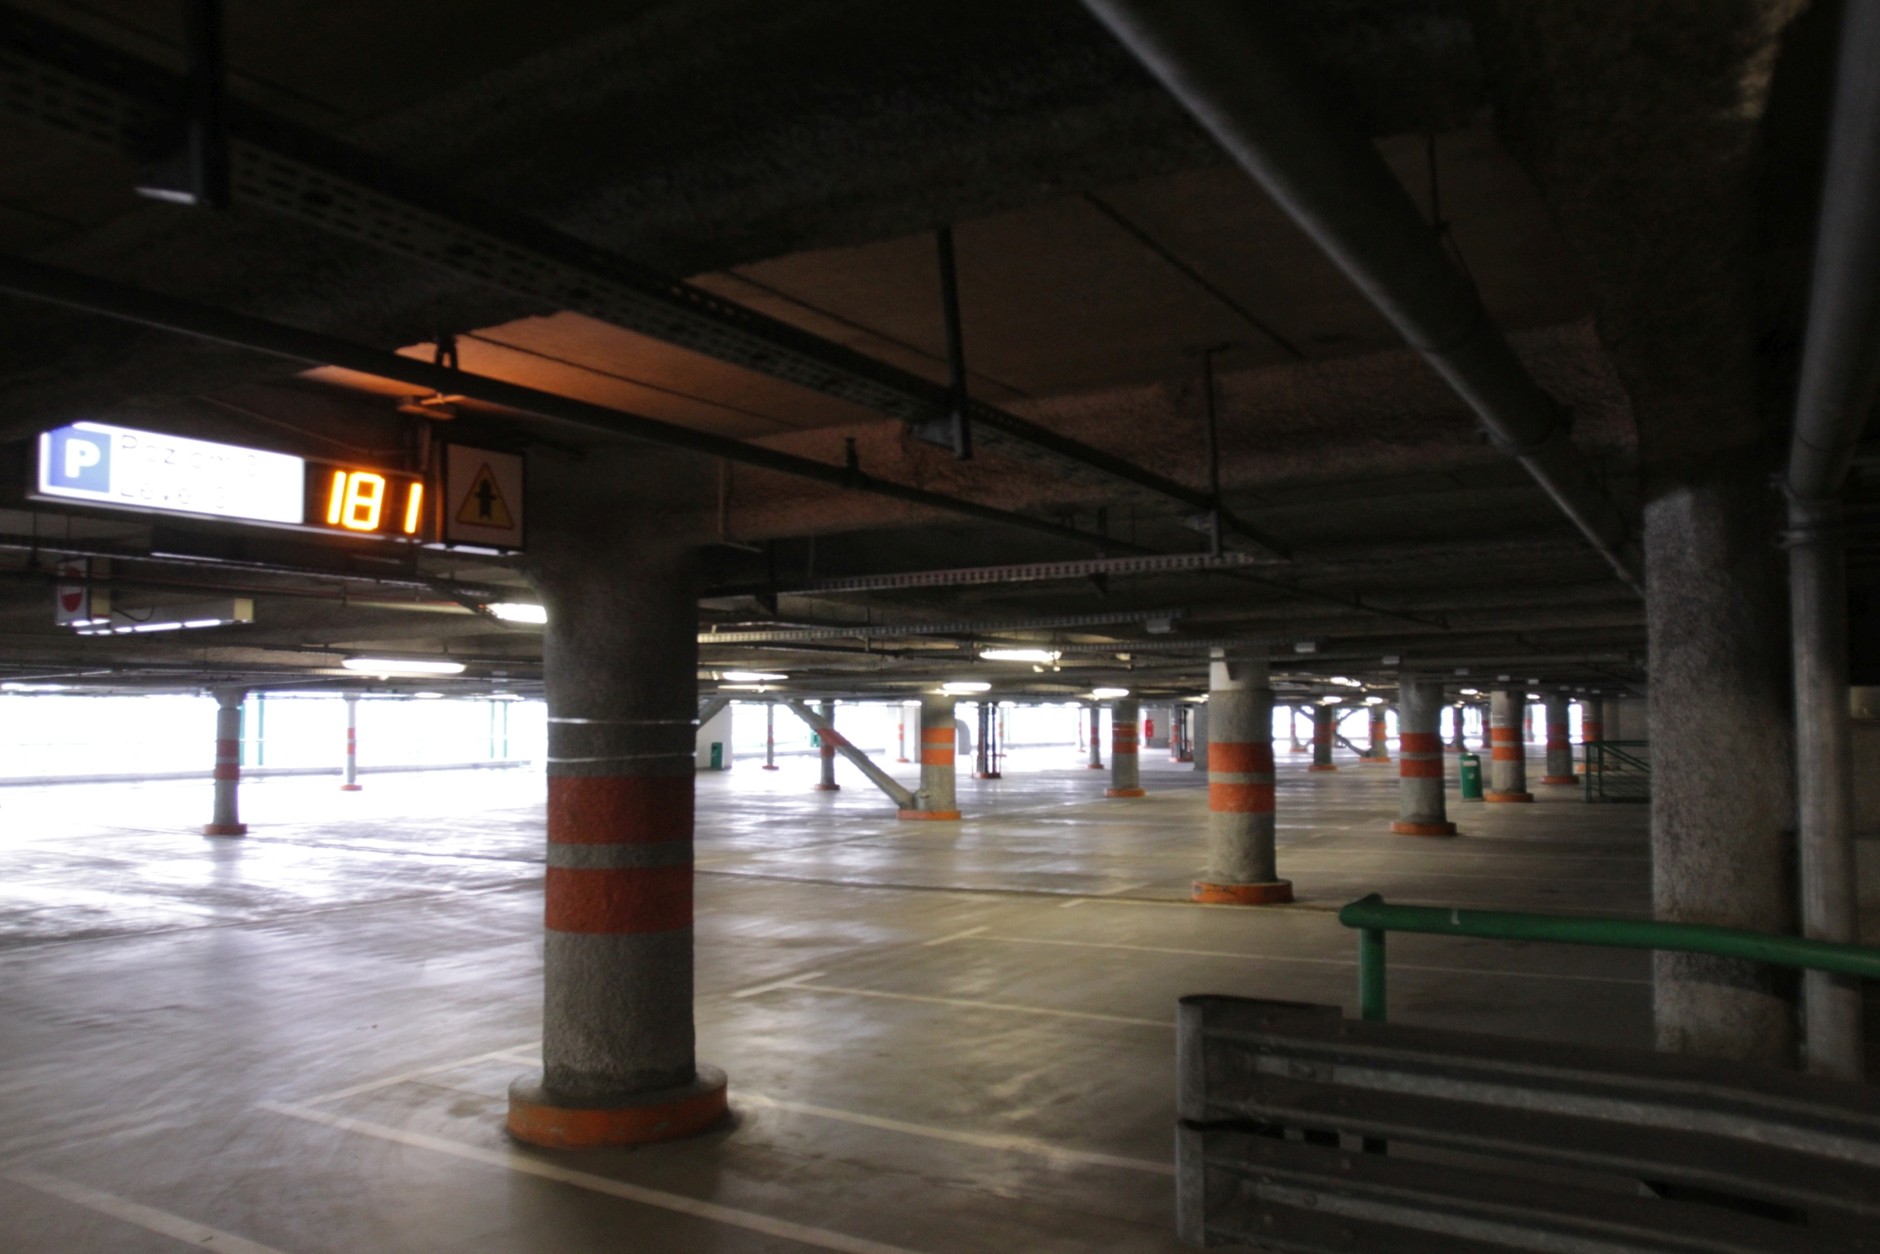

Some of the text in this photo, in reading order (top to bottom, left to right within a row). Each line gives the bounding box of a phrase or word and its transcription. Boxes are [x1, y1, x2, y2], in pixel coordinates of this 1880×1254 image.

[66, 440, 100, 477] P
[121, 434, 233, 475] Pozom
[121, 475, 197, 506] Leve
[327, 469, 423, 534] 181
